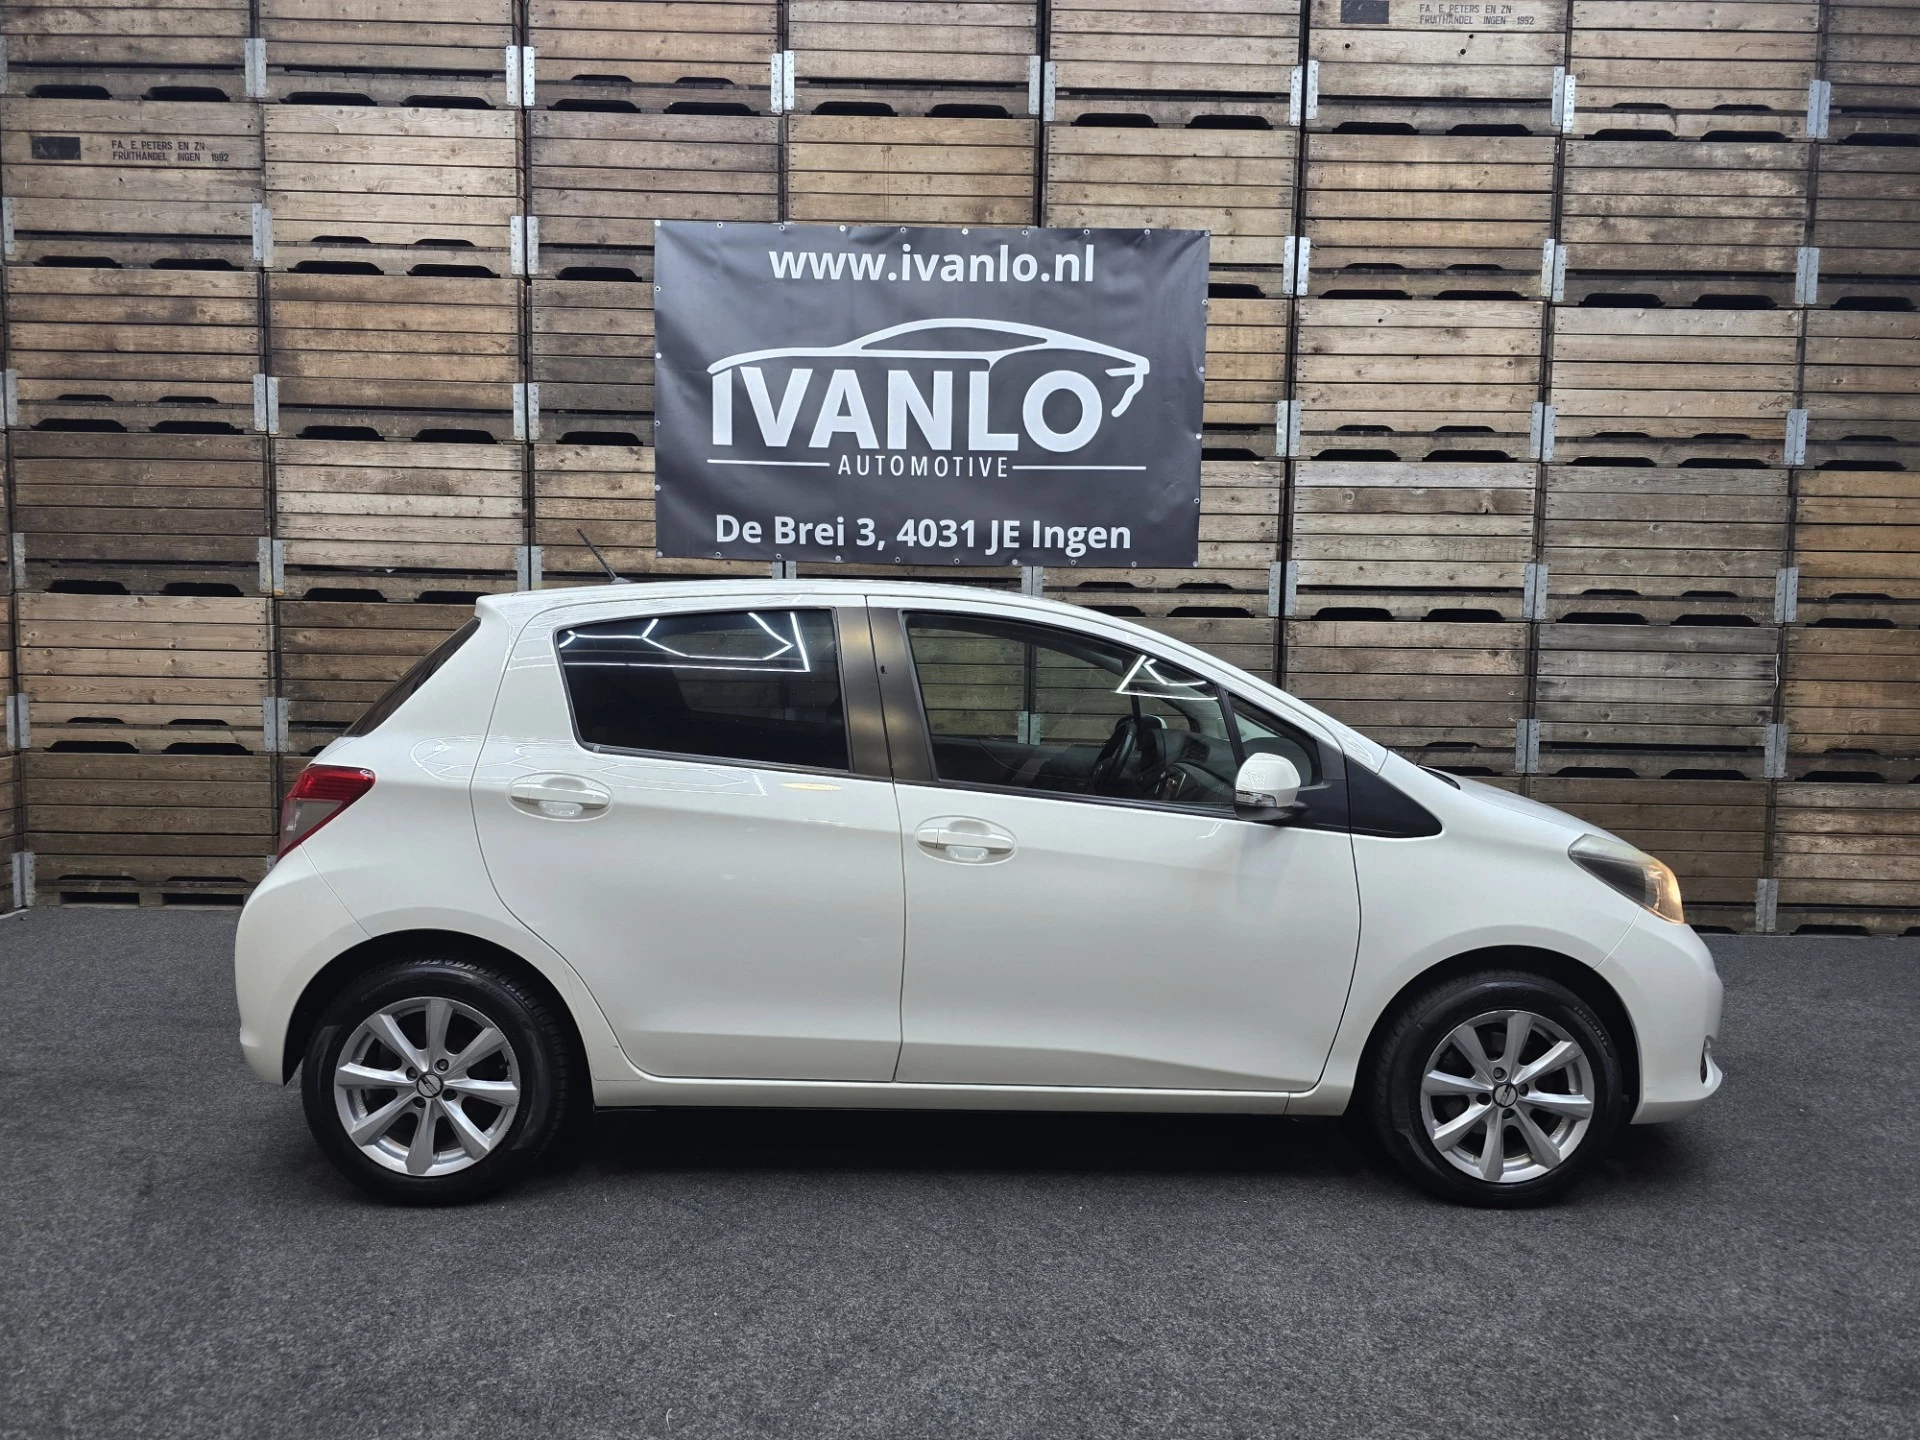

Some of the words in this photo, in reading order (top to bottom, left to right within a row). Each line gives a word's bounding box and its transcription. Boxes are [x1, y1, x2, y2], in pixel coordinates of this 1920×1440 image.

[1449, 4, 1480, 14] PETERS
[1485, 4, 1496, 14] EN
[1500, 4, 1512, 14] ZN
[1419, 14, 1474, 25] FRUITHANDEL
[1483, 15, 1507, 25] INGEN
[1516, 15, 1535, 25] 1992
[141, 140, 173, 151] PETERS
[178, 141, 189, 151] EN
[194, 141, 205, 151] ZN
[112, 151, 168, 162] FRUITHANDEL
[177, 152, 201, 162] INGEN
[211, 152, 230, 162] 1992
[769, 243, 1095, 283] www.ivanlo.nl
[711, 365, 1103, 453] IVANLO
[837, 454, 1009, 478] AUTOMOTIVE
[716, 514, 762, 544] De
[774, 515, 845, 546] Brei
[856, 517, 886, 551] 3,
[896, 518, 976, 548] 4031
[985, 519, 1021, 555] JE
[1033, 520, 1132, 557] Ingen
